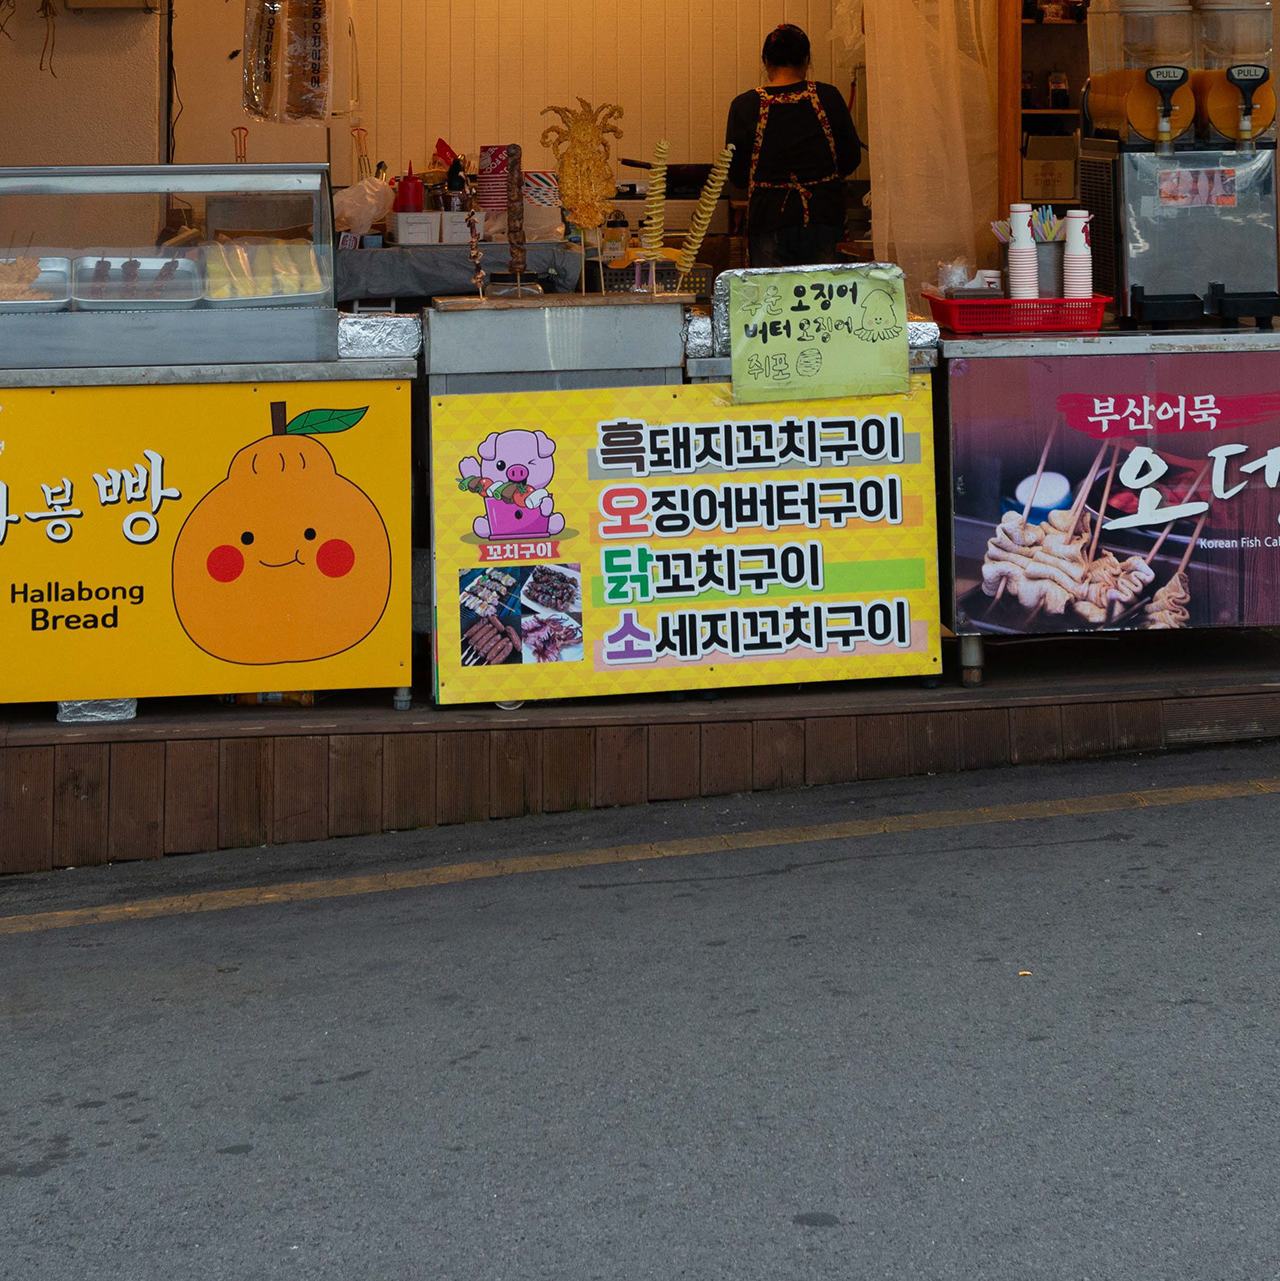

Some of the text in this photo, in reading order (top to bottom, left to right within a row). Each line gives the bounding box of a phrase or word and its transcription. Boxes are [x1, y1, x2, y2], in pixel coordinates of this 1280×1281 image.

[1156, 70, 1179, 79] PULL
[1237, 69, 1260, 77] PULL
[790, 281, 858, 311] 오징어
[744, 316, 853, 344] 버터 오징어
[747, 352, 791, 380] 쥐포
[1087, 394, 1221, 432] 부산어묵
[597, 415, 903, 476] 흑돼지꼬치구이
[599, 475, 902, 539] 오징어버터구이
[485, 541, 553, 561] 꼬치구이
[1199, 537, 1238, 549] Korean
[1240, 536, 1262, 548] Fish
[601, 540, 823, 603] 닭꼬치구이
[10, 581, 145, 605] Hallabong
[31, 606, 119, 631] Bread
[604, 599, 910, 663] 소세지꼬치구이
